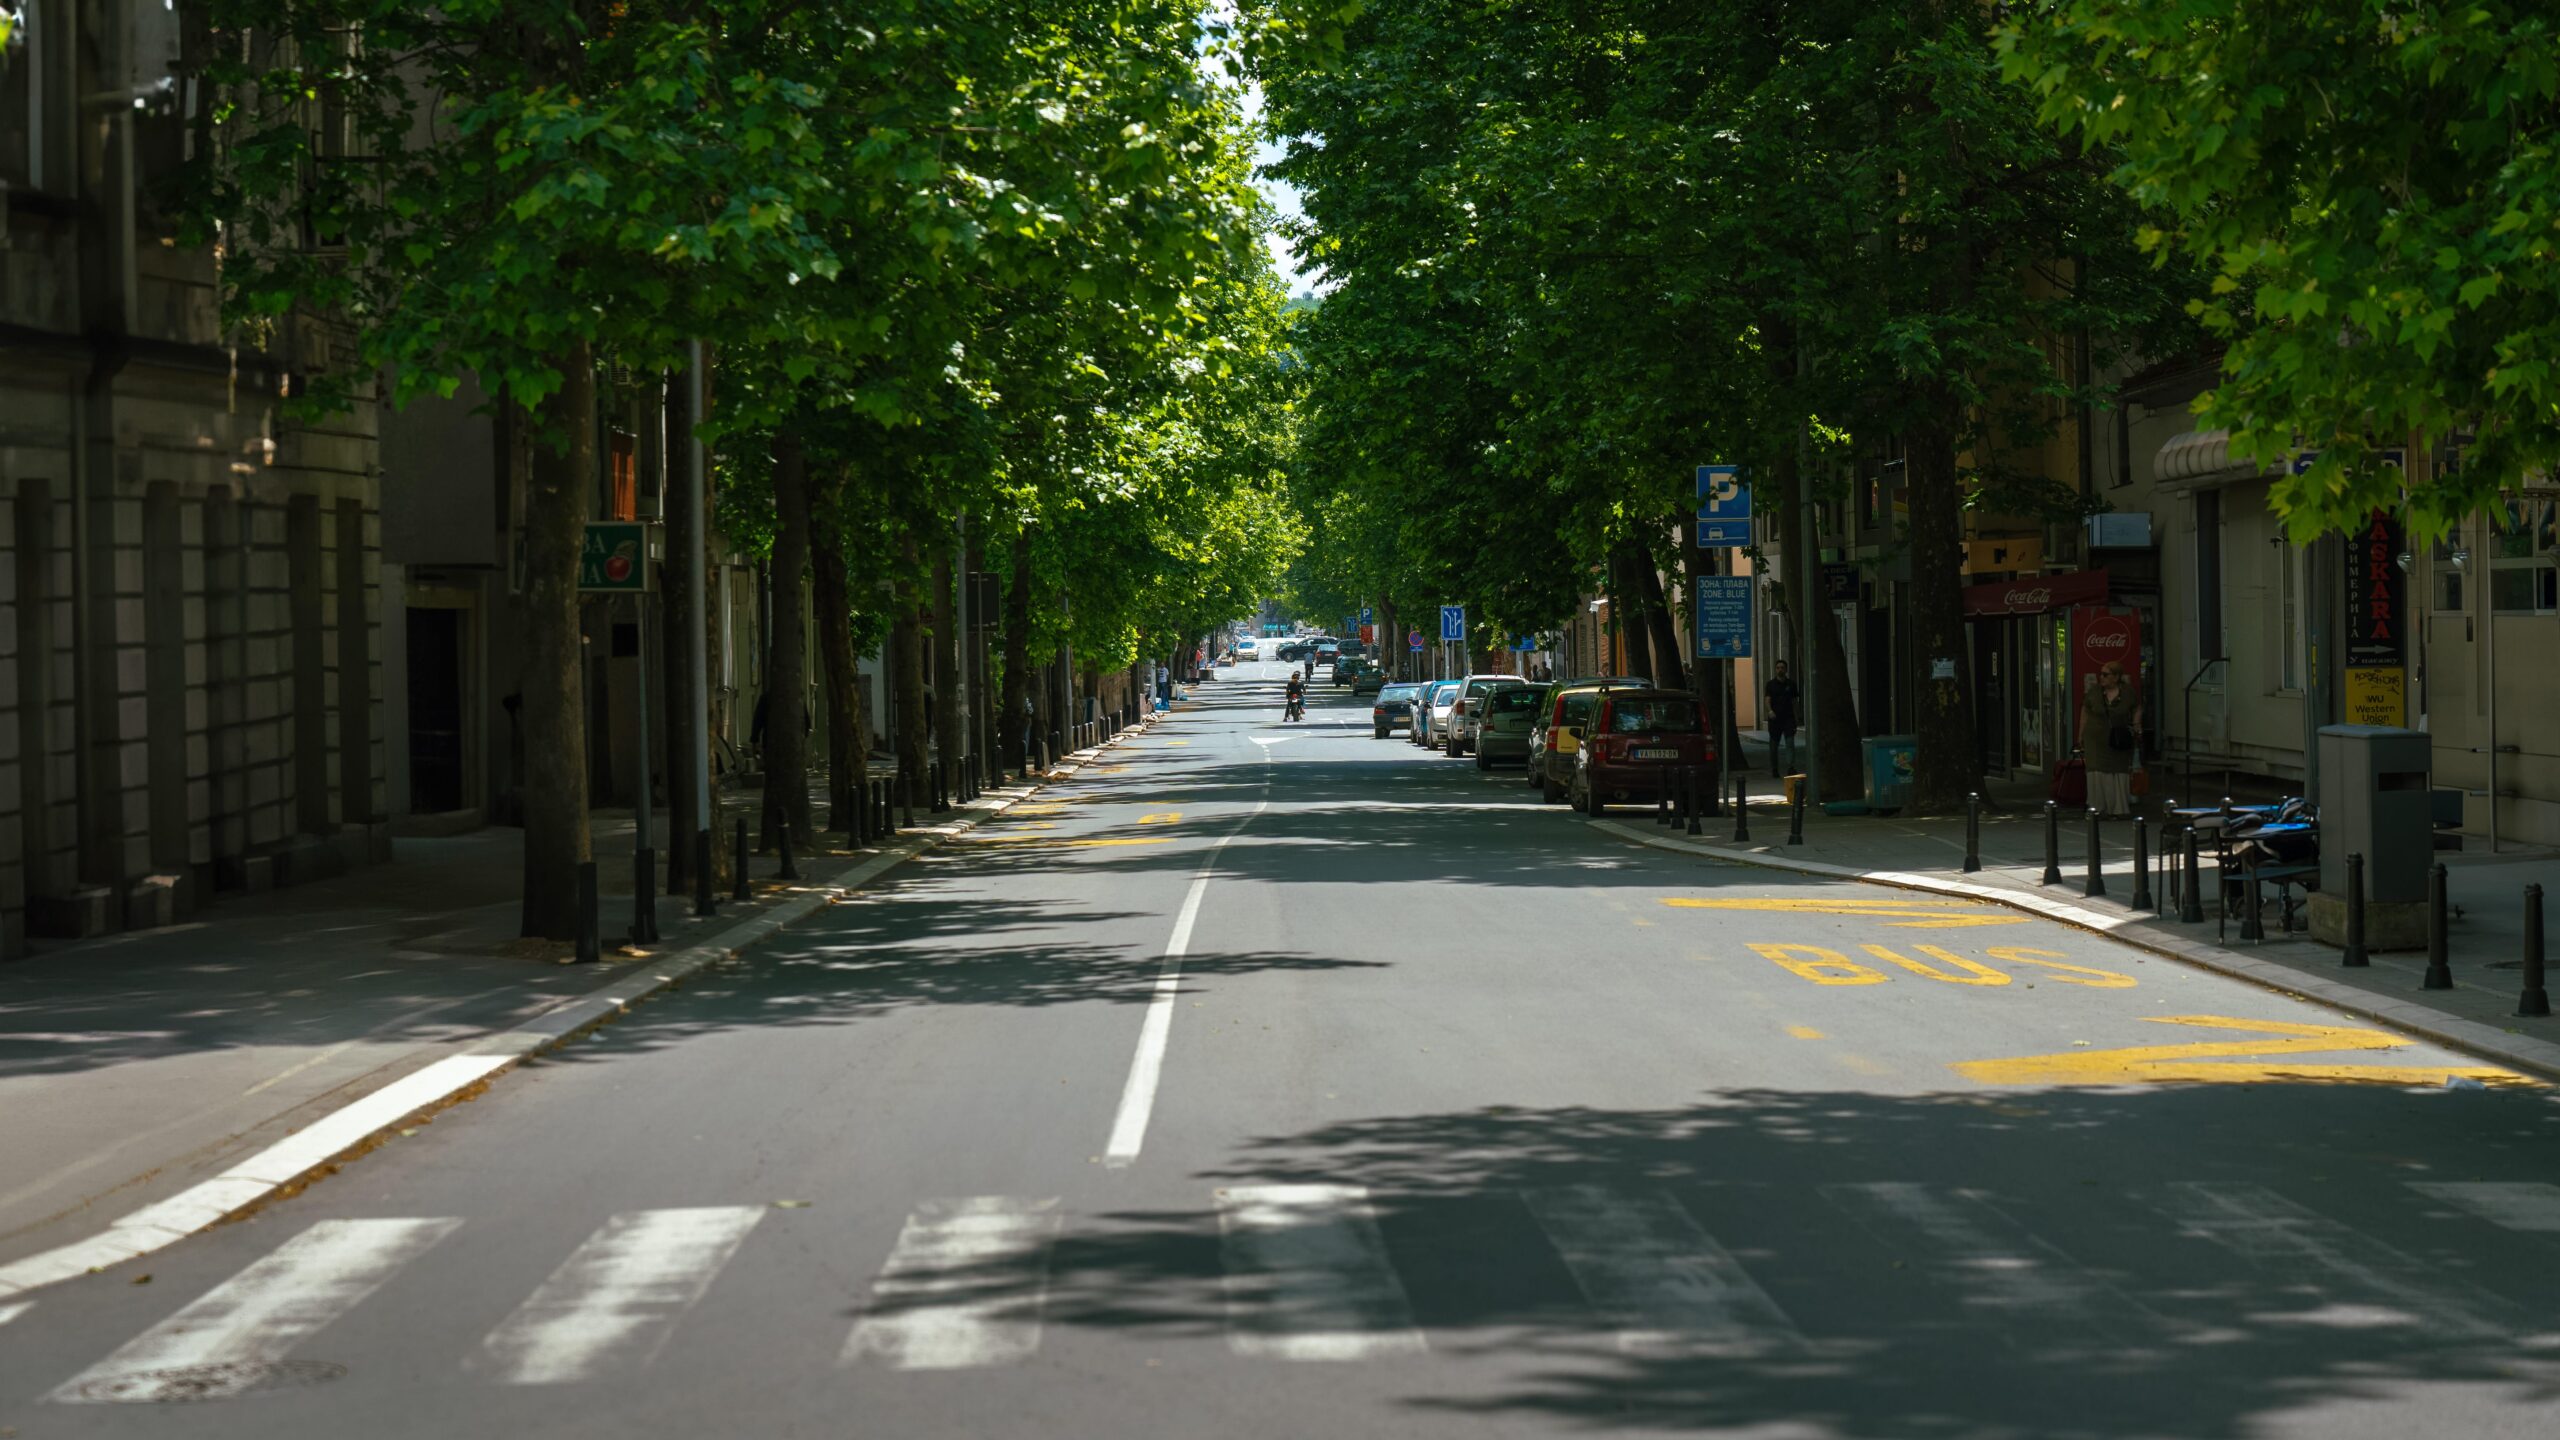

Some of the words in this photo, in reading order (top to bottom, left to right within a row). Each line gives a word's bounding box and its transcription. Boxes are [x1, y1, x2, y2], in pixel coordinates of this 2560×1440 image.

[1709, 472, 1739, 513] P
[1699, 579, 1722, 589] ЗОНА:
[1723, 579, 1749, 589] ПЛАВА
[1702, 589, 1725, 599] ZONE:
[1726, 589, 1746, 598] BLUE
[2347, 541, 2360, 639] ФИМЕРИЈА
[2367, 695, 2384, 703] WU
[2355, 705, 2396, 713] Western
[2362, 713, 2390, 722] Union
[1744, 943, 2139, 988] BUS
